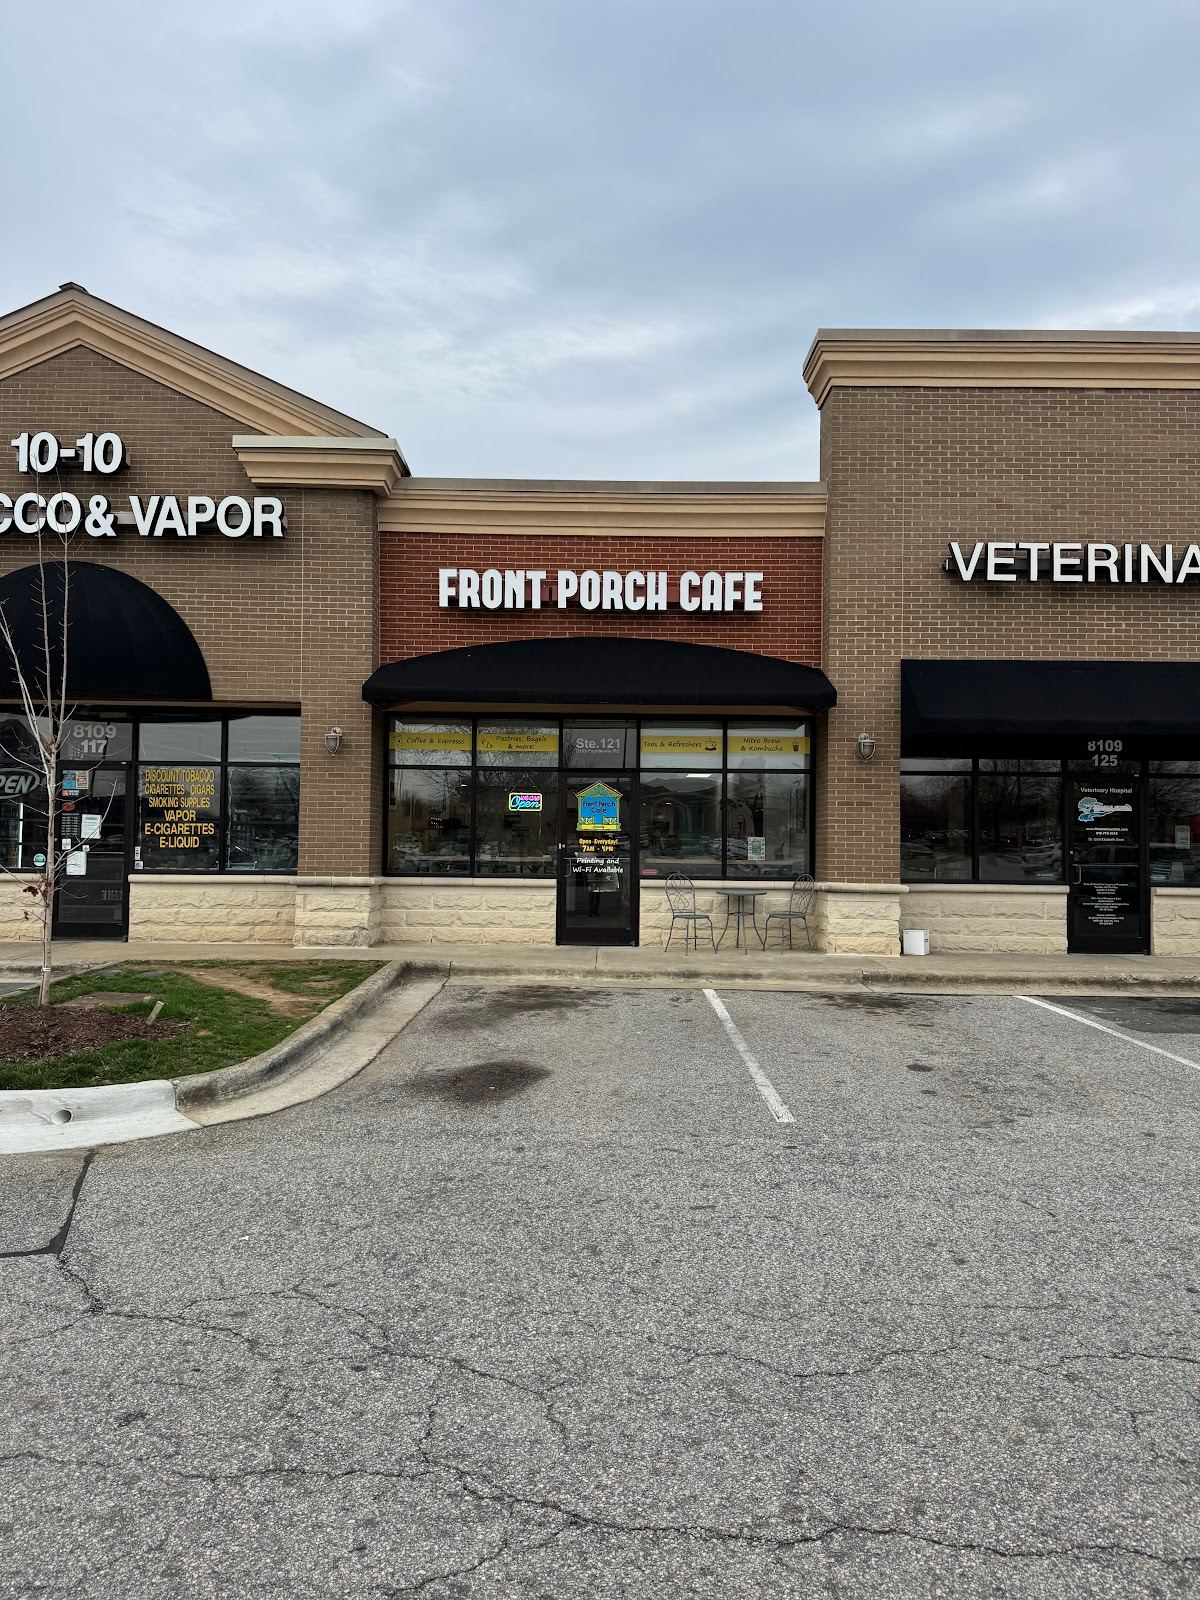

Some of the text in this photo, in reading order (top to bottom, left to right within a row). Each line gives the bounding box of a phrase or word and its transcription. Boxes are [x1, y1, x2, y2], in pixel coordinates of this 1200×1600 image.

[11, 432, 123, 473] 10-10
[129, 495, 284, 537] VAPOR
[950, 542, 1200, 583] VETERINA
[439, 569, 764, 611] FRONT PORCH CAFE
[73, 725, 116, 739] 8109
[81, 739, 107, 753] 117
[406, 737, 465, 746] Coffee & Espresso
[668, 740, 702, 748] Refreshers
[748, 744, 784, 752] Kombucha
[1087, 740, 1122, 753] 8109
[1092, 754, 1118, 767] 125
[145, 769, 215, 783] DISCOUNT TOBACCO
[144, 783, 215, 796] CIGARETTES CIGARS
[148, 797, 211, 808] SMOKING SUPPLIES
[511, 795, 541, 810] Open
[164, 809, 196, 821] VAPOR
[144, 823, 215, 835] E-CIGARETTES
[159, 836, 200, 848] E-LIQUID
[578, 838, 592, 846] Open
[576, 857, 605, 865] Printing
[593, 866, 624, 874] Available
